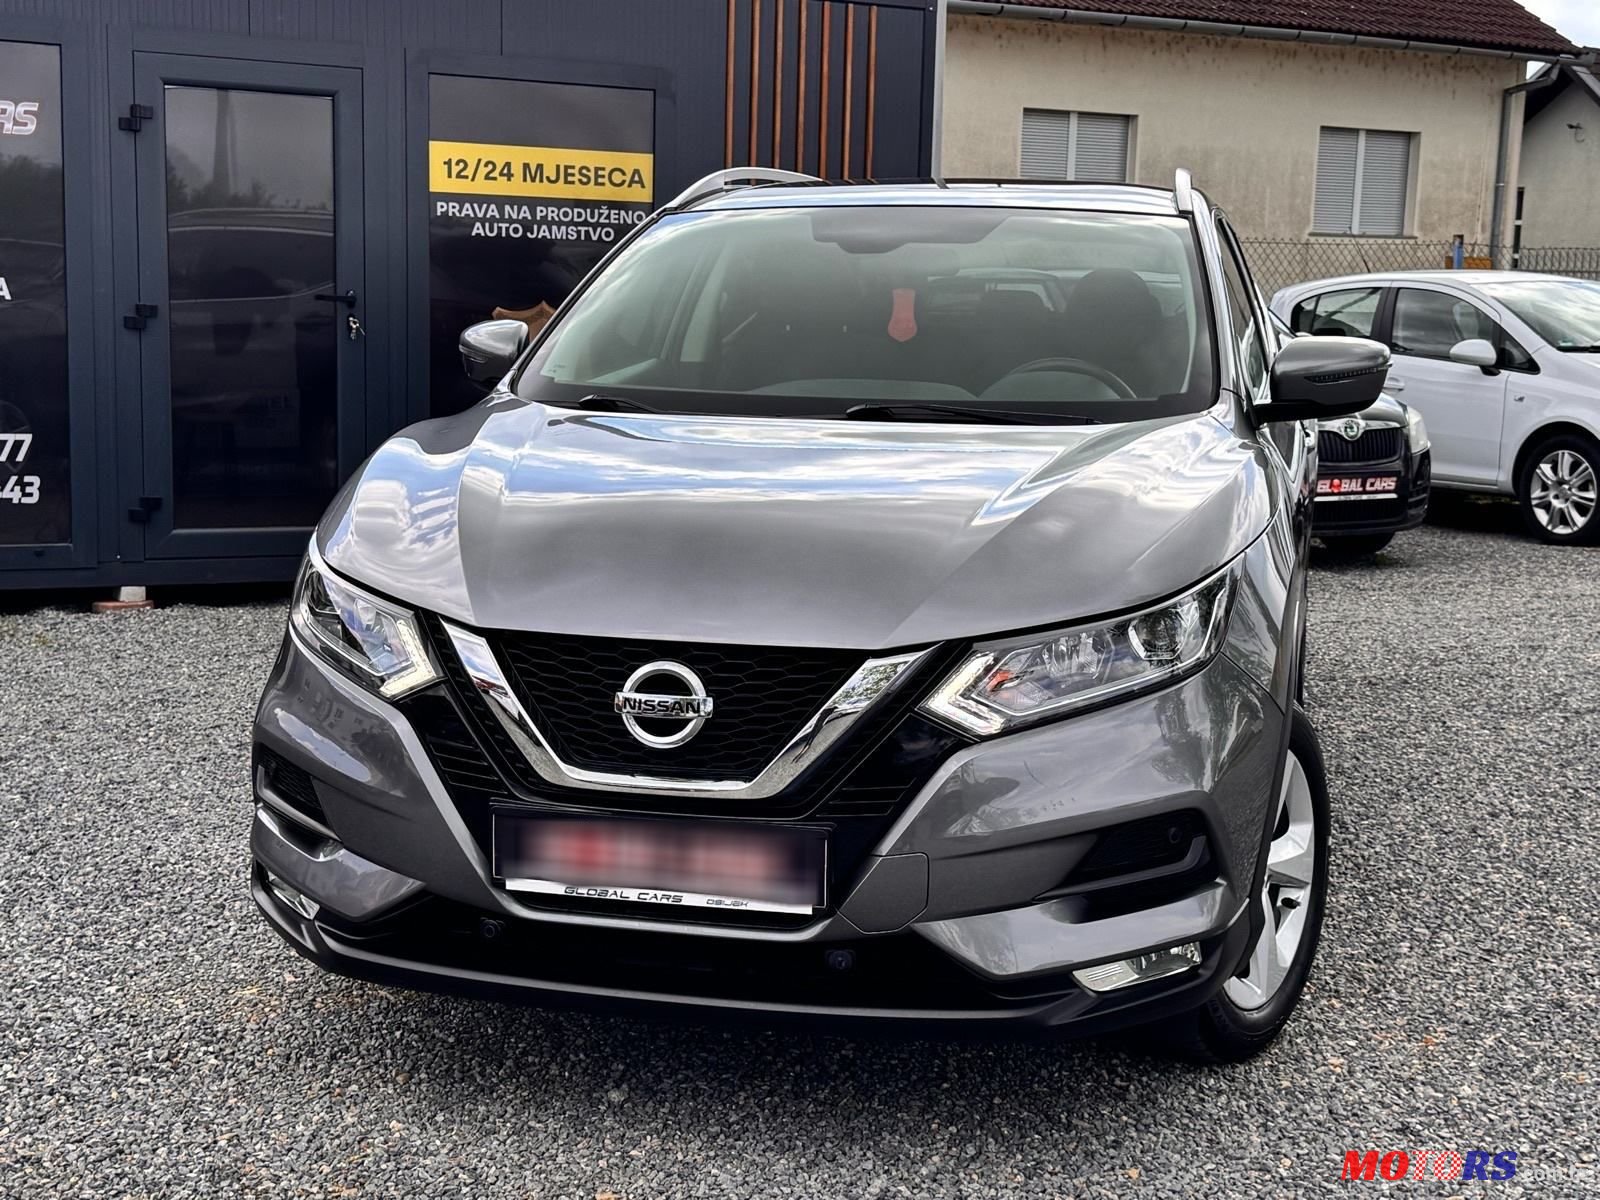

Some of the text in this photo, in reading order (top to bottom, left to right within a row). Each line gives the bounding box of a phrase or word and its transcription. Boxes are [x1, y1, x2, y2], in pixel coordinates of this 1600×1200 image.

[443, 157, 646, 188] 12/24 MJESECA
[436, 201, 647, 225] PRAVA NA PRODUŽENO
[471, 222, 615, 242] AUTO JAMSTVO
[0, 475, 41, 504] 43
[1365, 477, 1397, 491] CARS
[622, 697, 700, 714] NISSAN
[564, 886, 630, 899] GLOBAL
[637, 892, 684, 903] CARS
